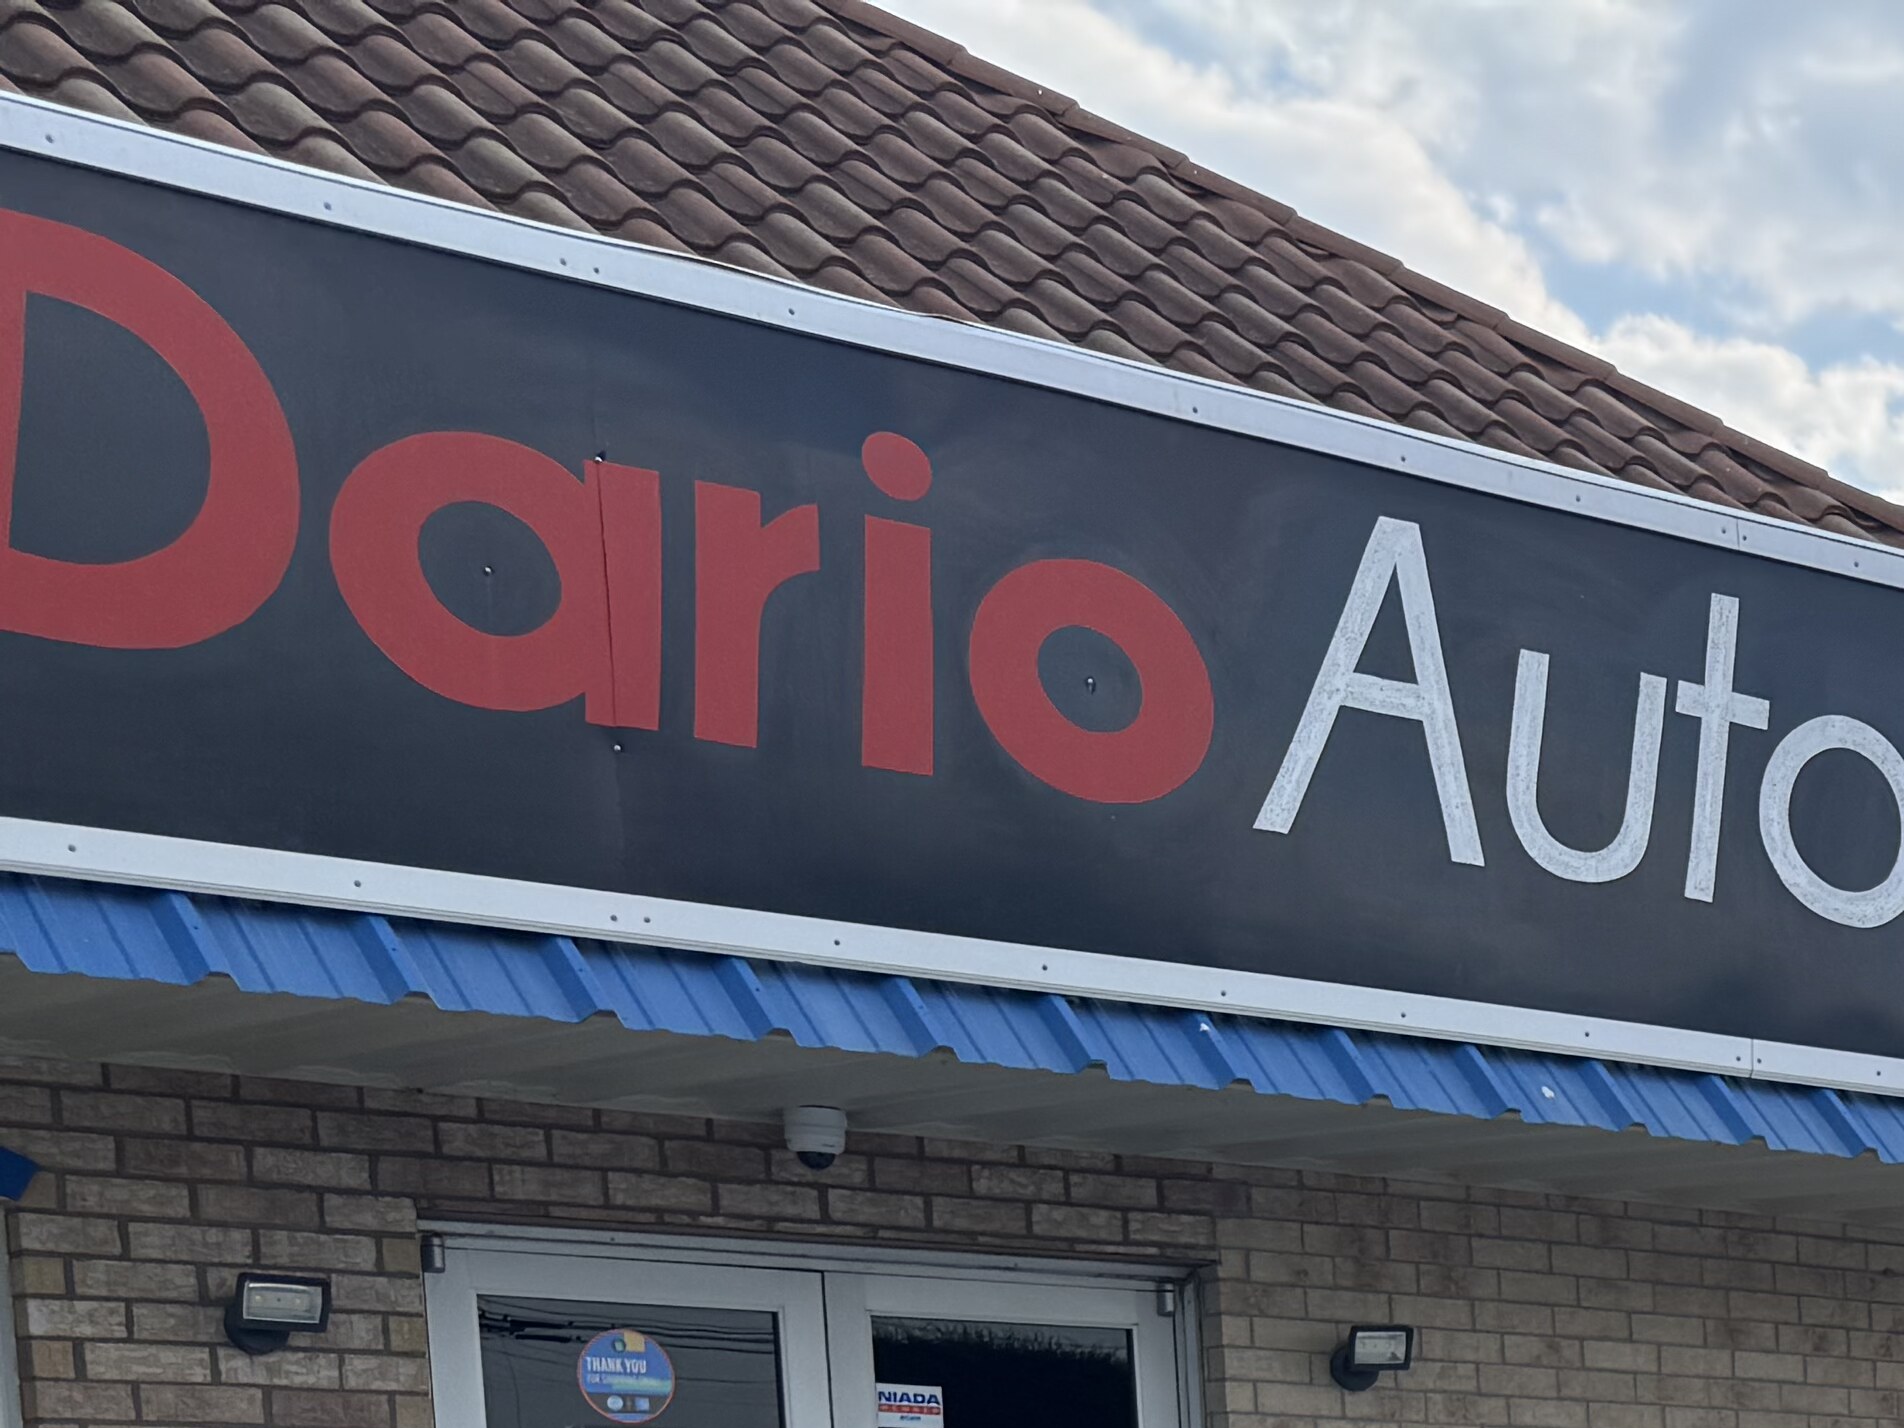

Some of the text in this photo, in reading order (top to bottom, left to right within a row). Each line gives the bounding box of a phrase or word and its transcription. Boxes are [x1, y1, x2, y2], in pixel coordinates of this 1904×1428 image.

[0, 212, 1214, 804] Dario
[585, 1357, 647, 1374] THANK YOU
[878, 1391, 940, 1405] NIADA
